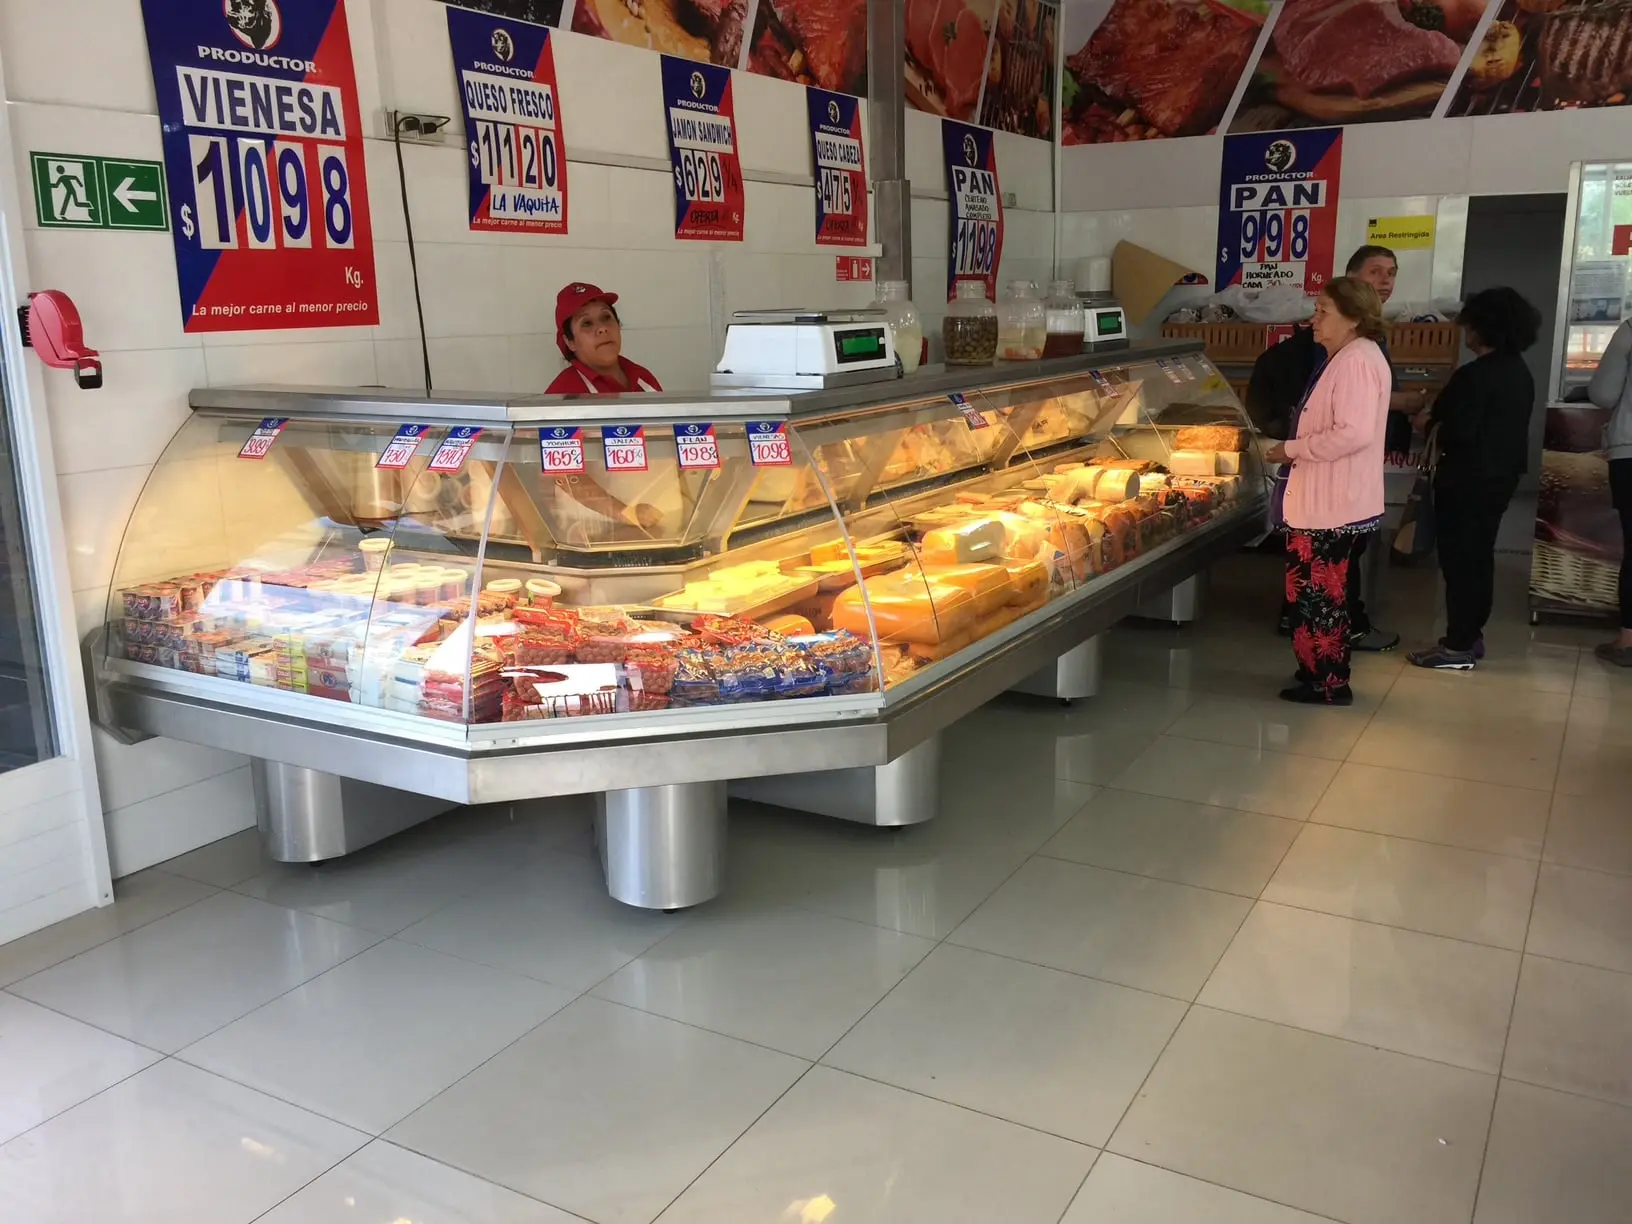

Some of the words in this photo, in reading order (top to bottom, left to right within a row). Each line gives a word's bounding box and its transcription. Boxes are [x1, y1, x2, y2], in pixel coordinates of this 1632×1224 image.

[197, 45, 317, 73] PRODUCTOR
[474, 61, 534, 79] PRODUCTOR
[184, 74, 341, 136] VIENESA
[466, 80, 506, 113] QUESO
[510, 88, 554, 120] FRESCO
[677, 99, 719, 112] PRODUCTOR
[673, 117, 697, 141] JAMON
[698, 120, 733, 146] SANDWICH
[820, 124, 850, 135] PRODUCTOR
[817, 139, 838, 161] QUESO
[838, 143, 861, 165] CABEZA
[955, 169, 994, 196] PAN
[1245, 171, 1314, 182] PRODUCTOR
[493, 194, 506, 212] LA
[1234, 182, 1320, 209] PAN
[473, 216, 482, 224] La
[482, 217, 499, 227] mejor
[501, 218, 517, 226] carne
[526, 220, 544, 228] menor
[545, 221, 562, 229] precio
[1370, 232, 1387, 240] Area
[1388, 231, 1430, 240] Restringida
[345, 266, 364, 288] Kg.
[1245, 270, 1294, 280] HORNEADO
[1242, 280, 1263, 289] CADA
[192, 304, 206, 316] La
[211, 304, 246, 317] mejor
[249, 303, 282, 314] carne
[286, 302, 296, 313] al
[299, 302, 333, 312] menor
[336, 300, 368, 313] precio
[682, 436, 708, 444] FLAN
